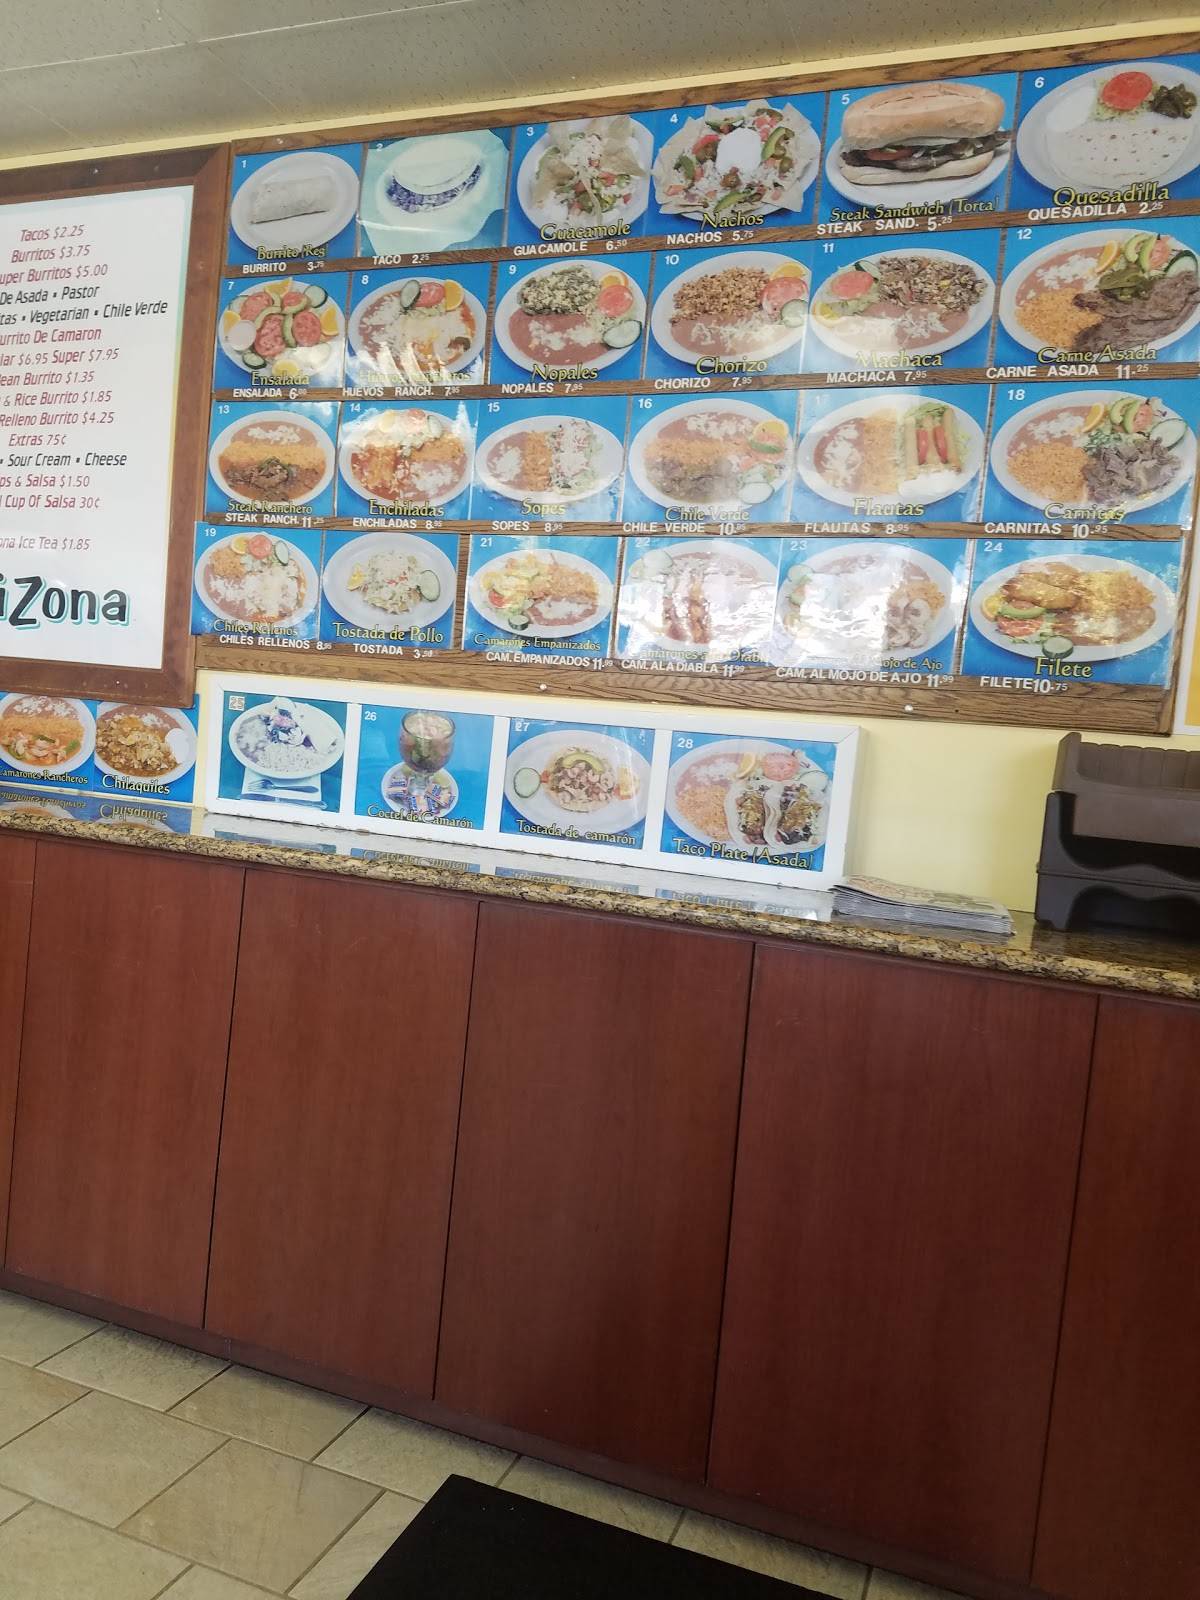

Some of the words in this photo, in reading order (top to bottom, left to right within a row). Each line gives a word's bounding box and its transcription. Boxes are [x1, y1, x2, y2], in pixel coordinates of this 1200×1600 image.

[1034, 77, 1044, 88] 6
[841, 94, 850, 105] 5
[670, 114, 678, 123] 4
[526, 127, 534, 136] 3
[241, 160, 247, 168] 1
[1052, 183, 1170, 208] Quesadilla
[831, 207, 871, 222] Steak
[874, 202, 944, 219] Sandwich
[1028, 205, 1126, 221] QUESADILLA
[1139, 201, 1163, 214] 2.25
[701, 212, 764, 232] Nachos
[817, 222, 862, 236] STEAK
[875, 218, 919, 231] SAND.
[927, 216, 952, 231] 5.25
[20, 228, 50, 242] Tacos
[53, 225, 84, 239] $2.25
[540, 220, 631, 241] Guacamole
[666, 232, 722, 245] NACHOS
[732, 230, 754, 241] 5.75
[1017, 228, 1032, 240] 12
[606, 240, 627, 251] 6.50
[823, 243, 834, 253] 11
[11, 248, 55, 263] Burritos
[60, 245, 91, 259] $3.75
[373, 255, 401, 265] TACO
[412, 254, 430, 264] 2.25
[665, 255, 679, 265] 10
[27, 267, 72, 282] Burritos
[76, 264, 108, 278] $5.00
[242, 263, 287, 273] BURRITO
[509, 265, 517, 275] 9
[228, 282, 234, 290] 7
[361, 275, 369, 285] 8
[15, 288, 48, 303] Asada
[62, 285, 100, 300] Pastor
[30, 307, 89, 325] Vegetarian
[103, 303, 132, 318] Chile
[134, 300, 168, 315] Verde
[33, 330, 48, 343] De
[51, 328, 101, 342] Camaron
[18, 349, 48, 366] $6.95
[51, 349, 84, 365] Super
[89, 347, 119, 362] $7.95
[856, 350, 944, 369] Machaca
[1038, 347, 1093, 364] Carne
[1094, 344, 1157, 362] Asada
[696, 356, 767, 375] Chorizo
[986, 366, 1036, 379] CARNE
[1048, 364, 1098, 377] ASADA
[1115, 364, 1149, 379] 11.25
[23, 370, 62, 385] Burrito
[66, 370, 95, 383] $1.35
[251, 372, 310, 386] Ensalada
[531, 363, 598, 384] Nopales
[827, 371, 896, 383] MACHACA
[904, 370, 927, 382] 7.95
[502, 383, 553, 394] NOPALES
[654, 378, 710, 390] CHORIZO
[732, 377, 752, 387] 7.95
[4, 396, 10, 407] &
[14, 393, 36, 406] Rice
[40, 391, 78, 405] Burrito
[82, 390, 112, 403] $1.85
[233, 387, 282, 398] ENSALADA
[343, 387, 383, 397] HUEVOS
[395, 387, 434, 396] RANCH.
[1008, 389, 1025, 400] 18
[218, 405, 229, 414] 13
[350, 403, 360, 413] 14
[488, 402, 500, 413] 15
[638, 398, 652, 409] 16
[40, 411, 78, 425] Burrito
[82, 412, 114, 424] $4.25
[8, 433, 43, 447] Extras
[8, 454, 32, 467] Sour
[35, 453, 71, 466] Cream
[85, 452, 127, 466] Cheese
[15, 477, 21, 487] &
[26, 473, 56, 487] Salsa
[59, 474, 90, 487] $1.50
[5, 494, 25, 510] Cup
[28, 495, 42, 508] Of
[44, 494, 76, 508] Salsa
[227, 501, 258, 514] Steak
[369, 499, 444, 517] Enchiladas
[521, 498, 565, 516] Sopes
[853, 498, 924, 517] Flautas
[225, 513, 257, 523] STEAK
[264, 514, 299, 524] RANCH.
[665, 506, 705, 521] Chile
[353, 518, 416, 529] ENCHILADAS
[492, 521, 529, 531] SOPES
[623, 523, 657, 533] CHILE
[664, 523, 705, 533] VERDE
[805, 522, 871, 534] FLAUTAS
[985, 522, 1062, 535] CARNITAS
[1071, 524, 1108, 538] 10.95
[205, 529, 216, 537] 19
[18, 536, 35, 549] Ice
[39, 536, 58, 549] Tea
[480, 538, 492, 548] 21
[790, 540, 807, 551] 23
[984, 541, 1002, 553] 24
[332, 622, 386, 639] Tostada
[390, 630, 404, 641] de
[409, 627, 444, 643] Pollo
[220, 635, 253, 645] CHILES
[258, 637, 310, 650] RELLENOS
[353, 643, 403, 655] TOSTADA
[473, 633, 530, 648] Camarones
[534, 637, 601, 651] Empanizados
[486, 652, 512, 662] CAM.
[513, 654, 589, 666] EMPANIZADOS
[1035, 657, 1092, 679] Filete
[980, 675, 1033, 690] FILETE
[364, 711, 377, 721] 26
[678, 738, 693, 749] 28
[43, 769, 88, 784] Rancheros
[102, 774, 170, 795] Chilaquiles
[367, 804, 404, 820] Coctel
[406, 809, 420, 822] de
[420, 812, 474, 828] Camarón
[516, 819, 562, 838] Tostada
[565, 825, 581, 839] de
[584, 830, 636, 845] camarón
[673, 838, 705, 857] Taco
[710, 841, 748, 861] Plate
